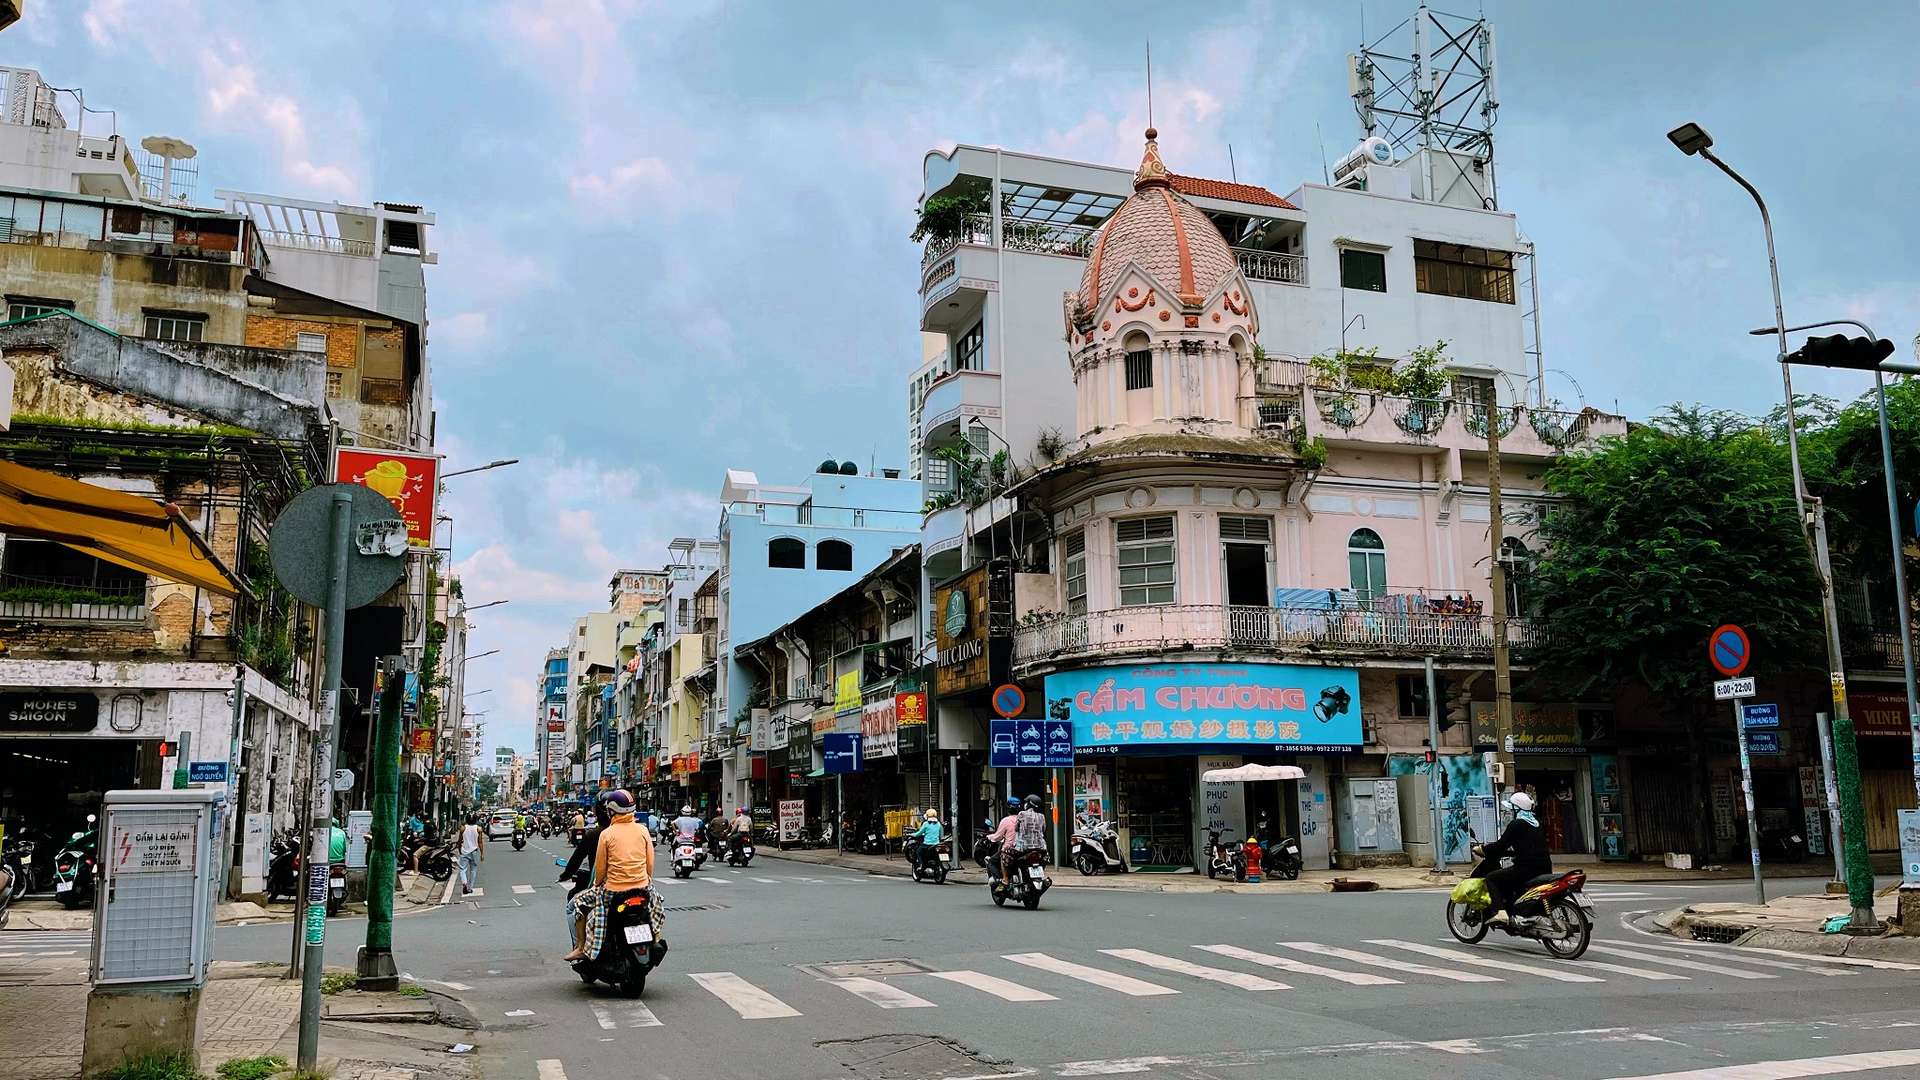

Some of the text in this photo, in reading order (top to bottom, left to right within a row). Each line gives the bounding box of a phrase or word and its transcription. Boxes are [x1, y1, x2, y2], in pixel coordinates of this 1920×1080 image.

[959, 638, 981, 662] LONG
[1075, 678, 1307, 715] CẨM CHƯƠNG
[23, 701, 77, 710] MORES
[9, 711, 66, 721] SAIGON
[1862, 710, 1902, 725] MINH
[784, 820, 800, 830] 69K
